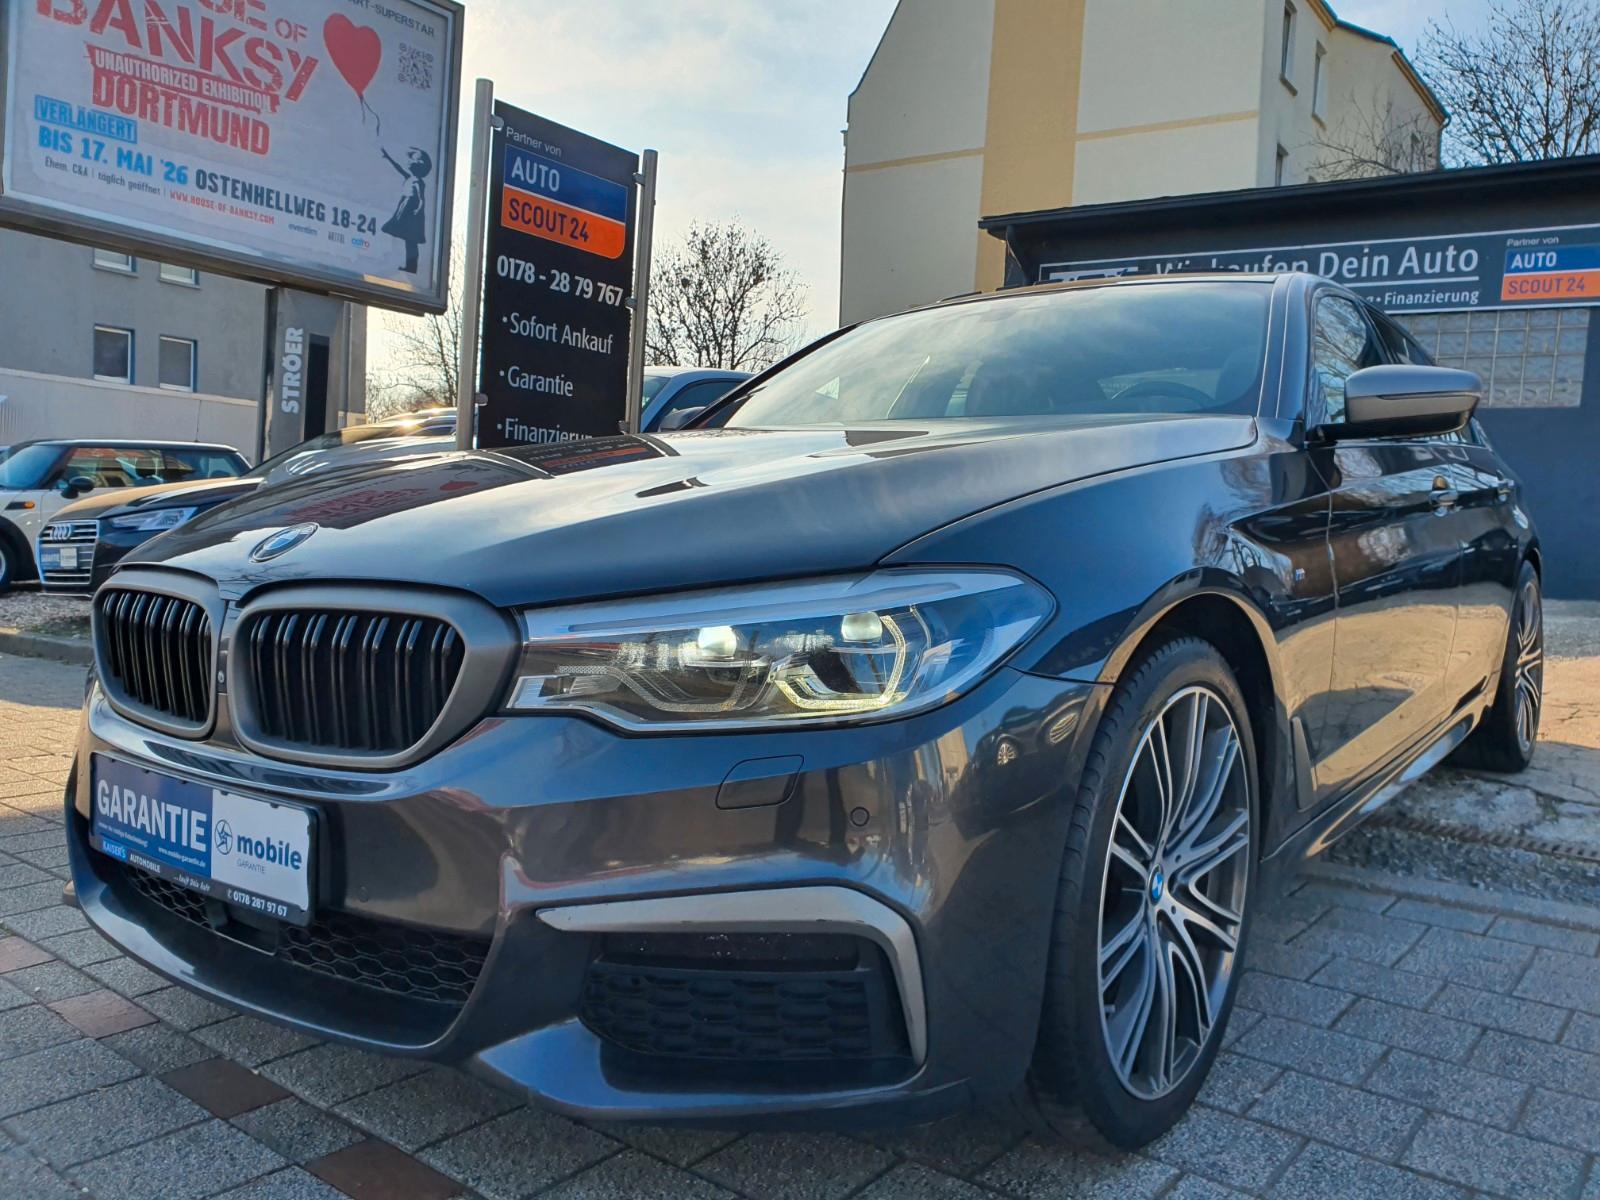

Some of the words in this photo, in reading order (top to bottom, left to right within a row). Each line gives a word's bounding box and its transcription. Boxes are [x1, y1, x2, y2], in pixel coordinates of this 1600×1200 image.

[274, 18, 308, 42] OF
[95, 48, 198, 92] UNAUTHORIZED
[202, 77, 271, 112] EXHIBITION
[39, 98, 134, 141] VERLÄNGERT
[93, 71, 271, 156] DORTMUND
[39, 125, 73, 154] BIS
[81, 137, 108, 164] 17.
[117, 147, 153, 177] MAI
[506, 126, 542, 150] Partner
[545, 143, 562, 157] von
[72, 163, 88, 177] C&A
[511, 156, 560, 192] AUTO
[195, 168, 326, 222] OSTENHELLWEG
[331, 206, 377, 236] 18-24
[1506, 238, 1540, 247] Partner
[1542, 236, 1560, 244] von
[1318, 247, 1390, 279] Dein
[1397, 244, 1479, 276] Auto
[1511, 251, 1558, 269] AUTO
[497, 255, 536, 284] 0178
[549, 269, 571, 293] 28
[574, 275, 593, 299] 79
[597, 282, 624, 307] 767
[1384, 289, 1480, 305] Finanzierung
[509, 312, 558, 343] Sofort
[560, 324, 614, 355] Ankauf
[281, 327, 304, 414] STRÖER
[507, 366, 574, 397] Garantie
[97, 779, 207, 853] GARANTIE
[129, 853, 161, 874] AUTOMOBILE
[236, 860, 266, 874] GARANTIE
[237, 834, 302, 870] mobile
